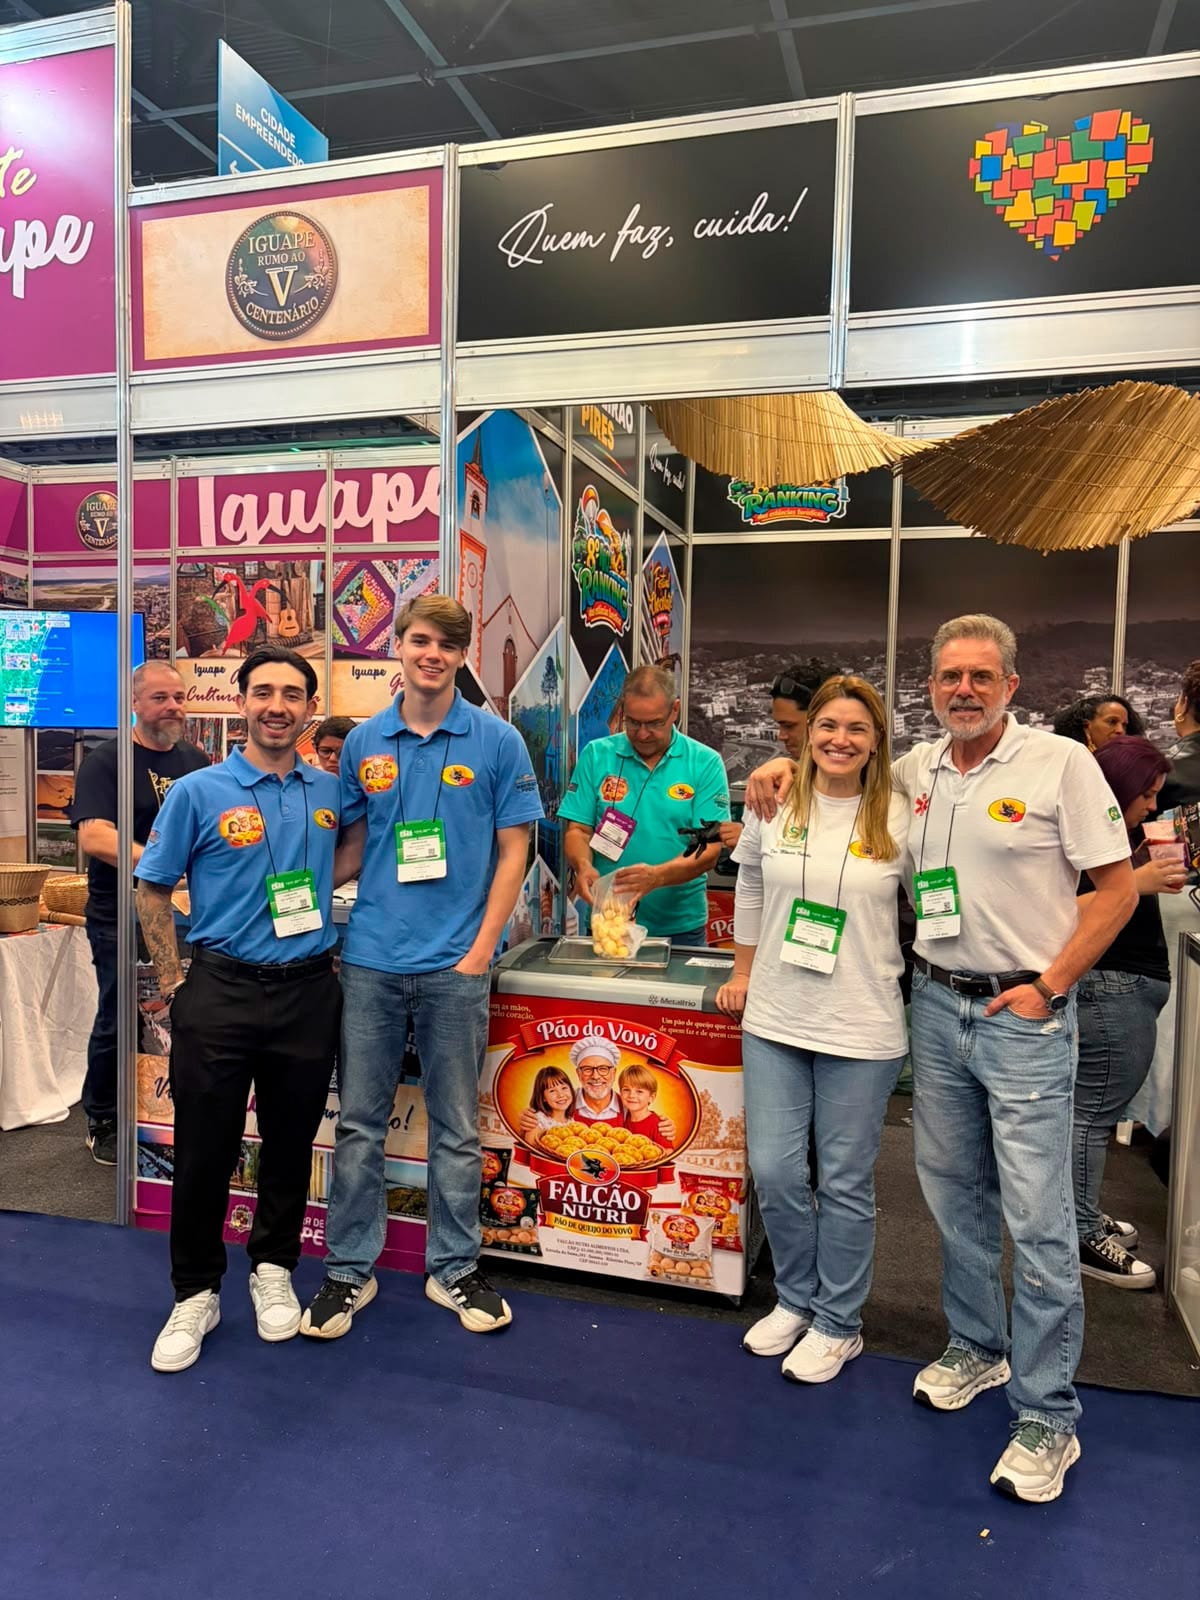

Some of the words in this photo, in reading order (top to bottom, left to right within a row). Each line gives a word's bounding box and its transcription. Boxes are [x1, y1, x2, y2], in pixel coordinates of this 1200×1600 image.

[260, 107, 296, 149] CIDADE
[497, 202, 606, 269] Quem
[609, 203, 674, 263] faz,
[693, 186, 809, 240] cuida!
[248, 231, 315, 254] IGUAPE
[257, 253, 289, 267] RUMO
[290, 251, 306, 262] AO
[265, 265, 299, 307] V
[245, 296, 320, 325] CENTENÁRIO
[581, 404, 615, 451] PIRES
[86, 501, 117, 512] IGUAPE
[741, 490, 838, 519] RANKING
[93, 517, 110, 538] V
[580, 567, 628, 619] RANKING
[194, 663, 226, 678] Iguape
[351, 664, 387, 680] Iguape
[710, 918, 734, 938] Pã
[686, 1018, 694, 1027] de
[582, 1019, 605, 1037] do
[607, 1022, 658, 1051] Vovô
[548, 1179, 641, 1211] FALCÃO
[562, 1202, 628, 1224] NUTRI
[568, 1220, 577, 1229] DE
[577, 1223, 602, 1234] QUEIJO
[602, 1226, 613, 1234] DO
[613, 1226, 633, 1235] VOVÔ
